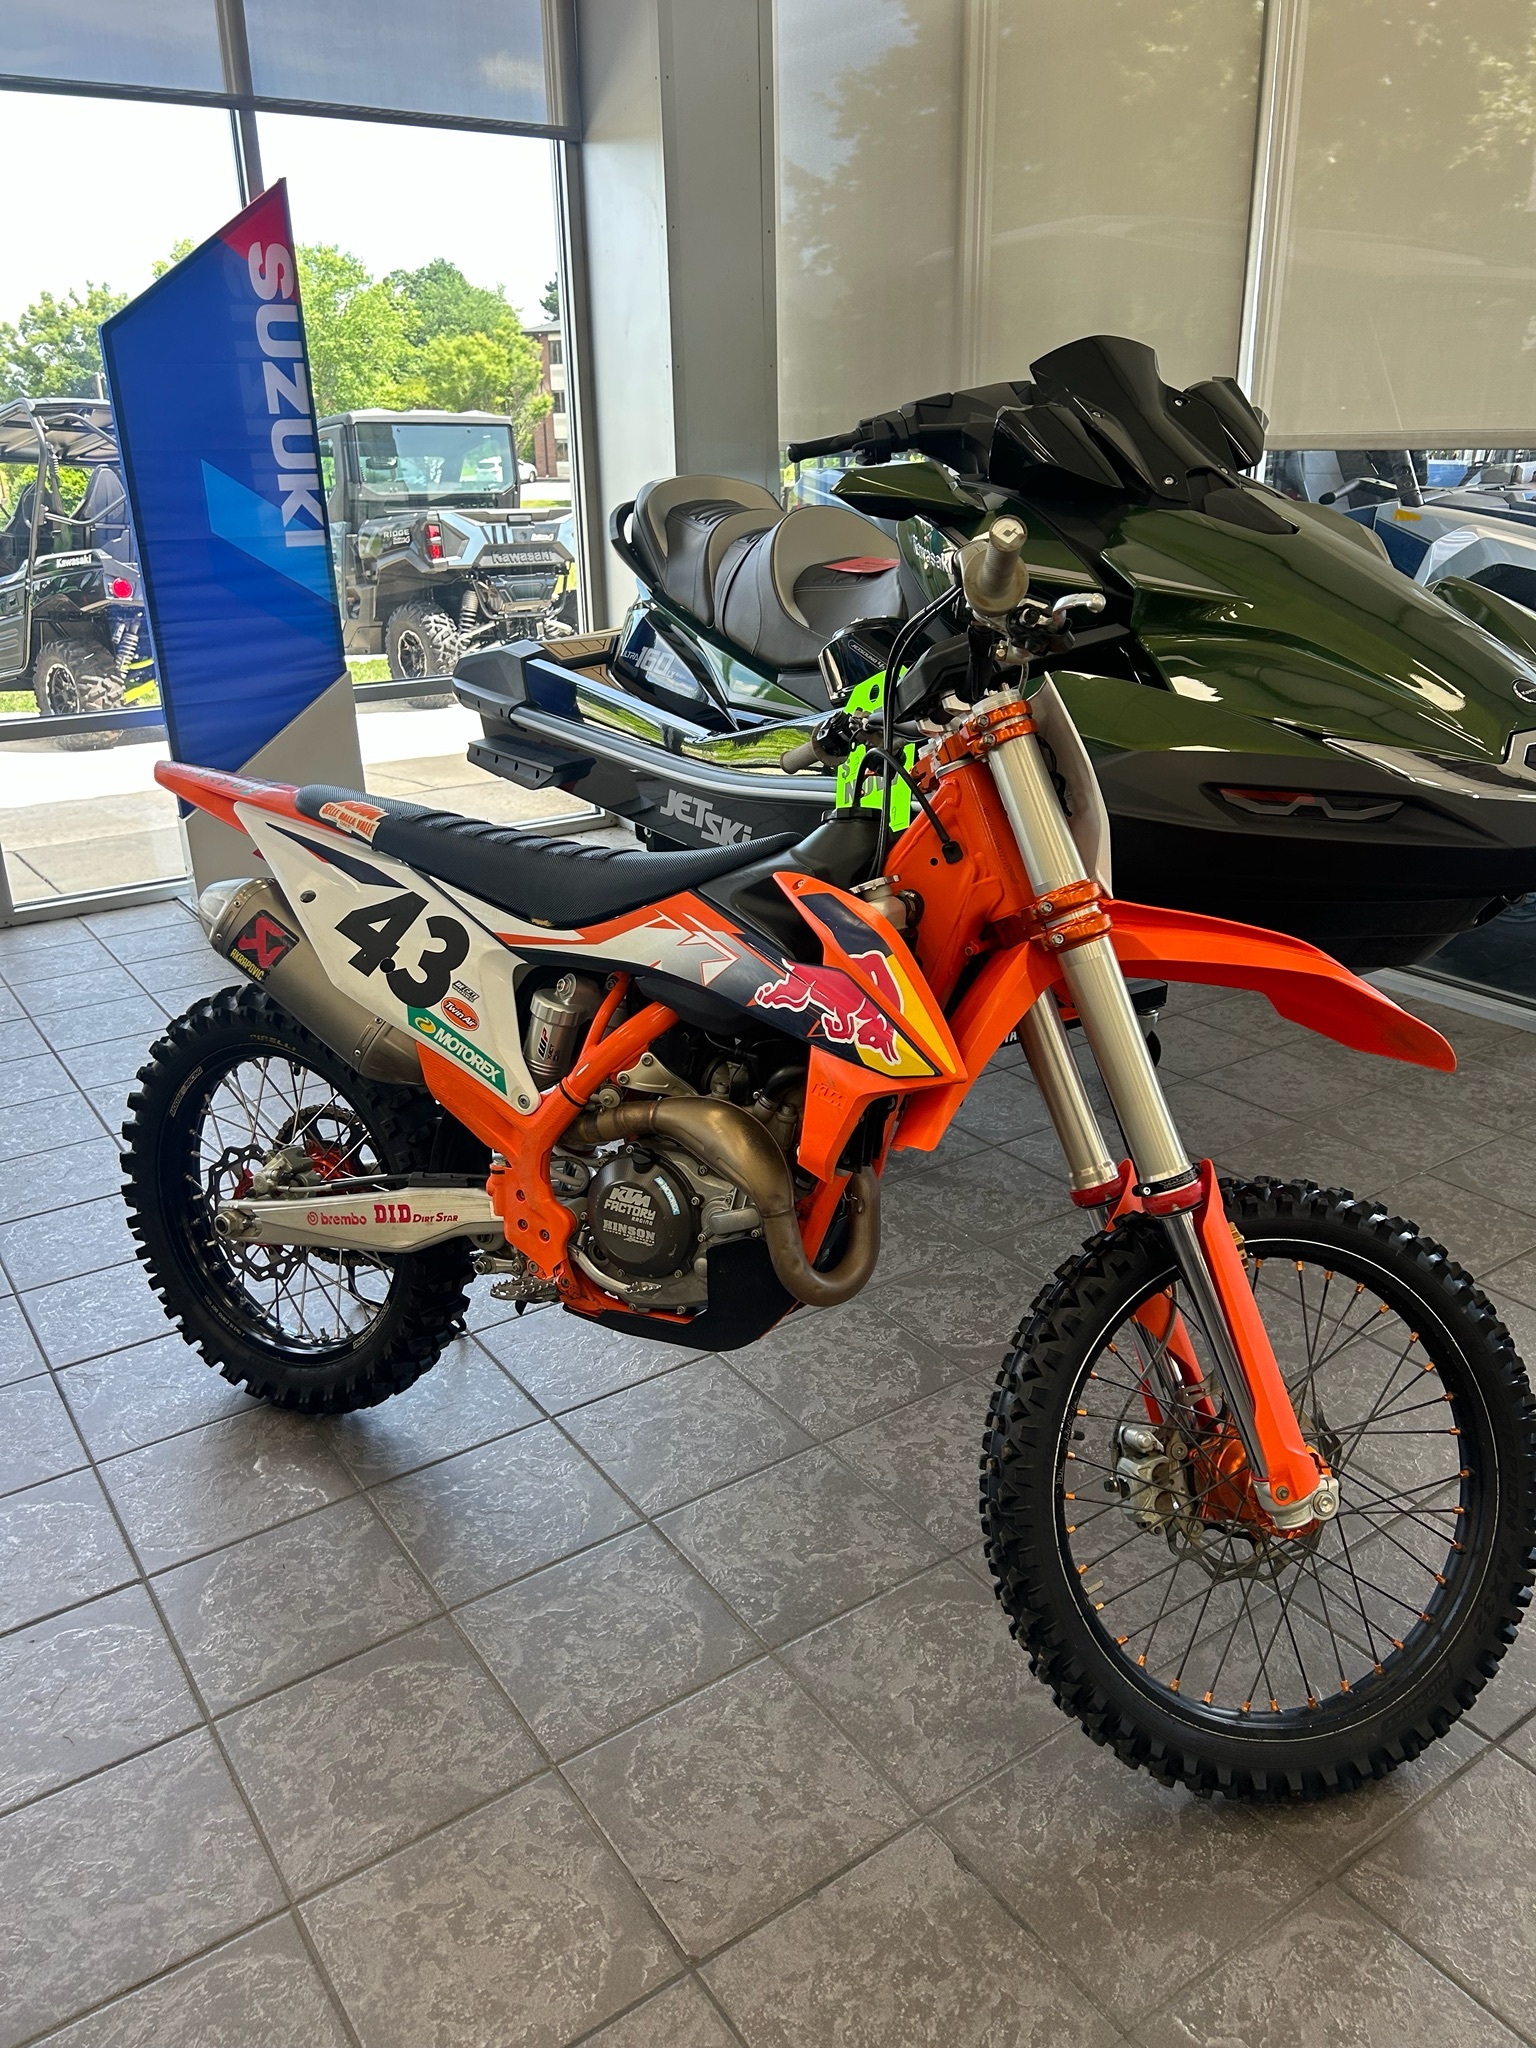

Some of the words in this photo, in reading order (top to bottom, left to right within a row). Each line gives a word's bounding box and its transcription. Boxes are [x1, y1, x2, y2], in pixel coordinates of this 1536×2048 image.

[247, 241, 326, 548] SUZUKI
[56, 554, 92, 569] Kawasaki
[491, 550, 553, 565] Kawasaki
[635, 646, 676, 676] 160
[334, 890, 471, 1009] 43
[444, 1001, 466, 1019] Twin
[462, 1015, 477, 1028] Air
[433, 1027, 501, 1083] MOTOREX
[609, 1185, 652, 1208] KTM
[320, 1212, 368, 1226] brembo
[603, 1198, 657, 1221] FACTORY
[602, 1219, 656, 1241] HINSON
